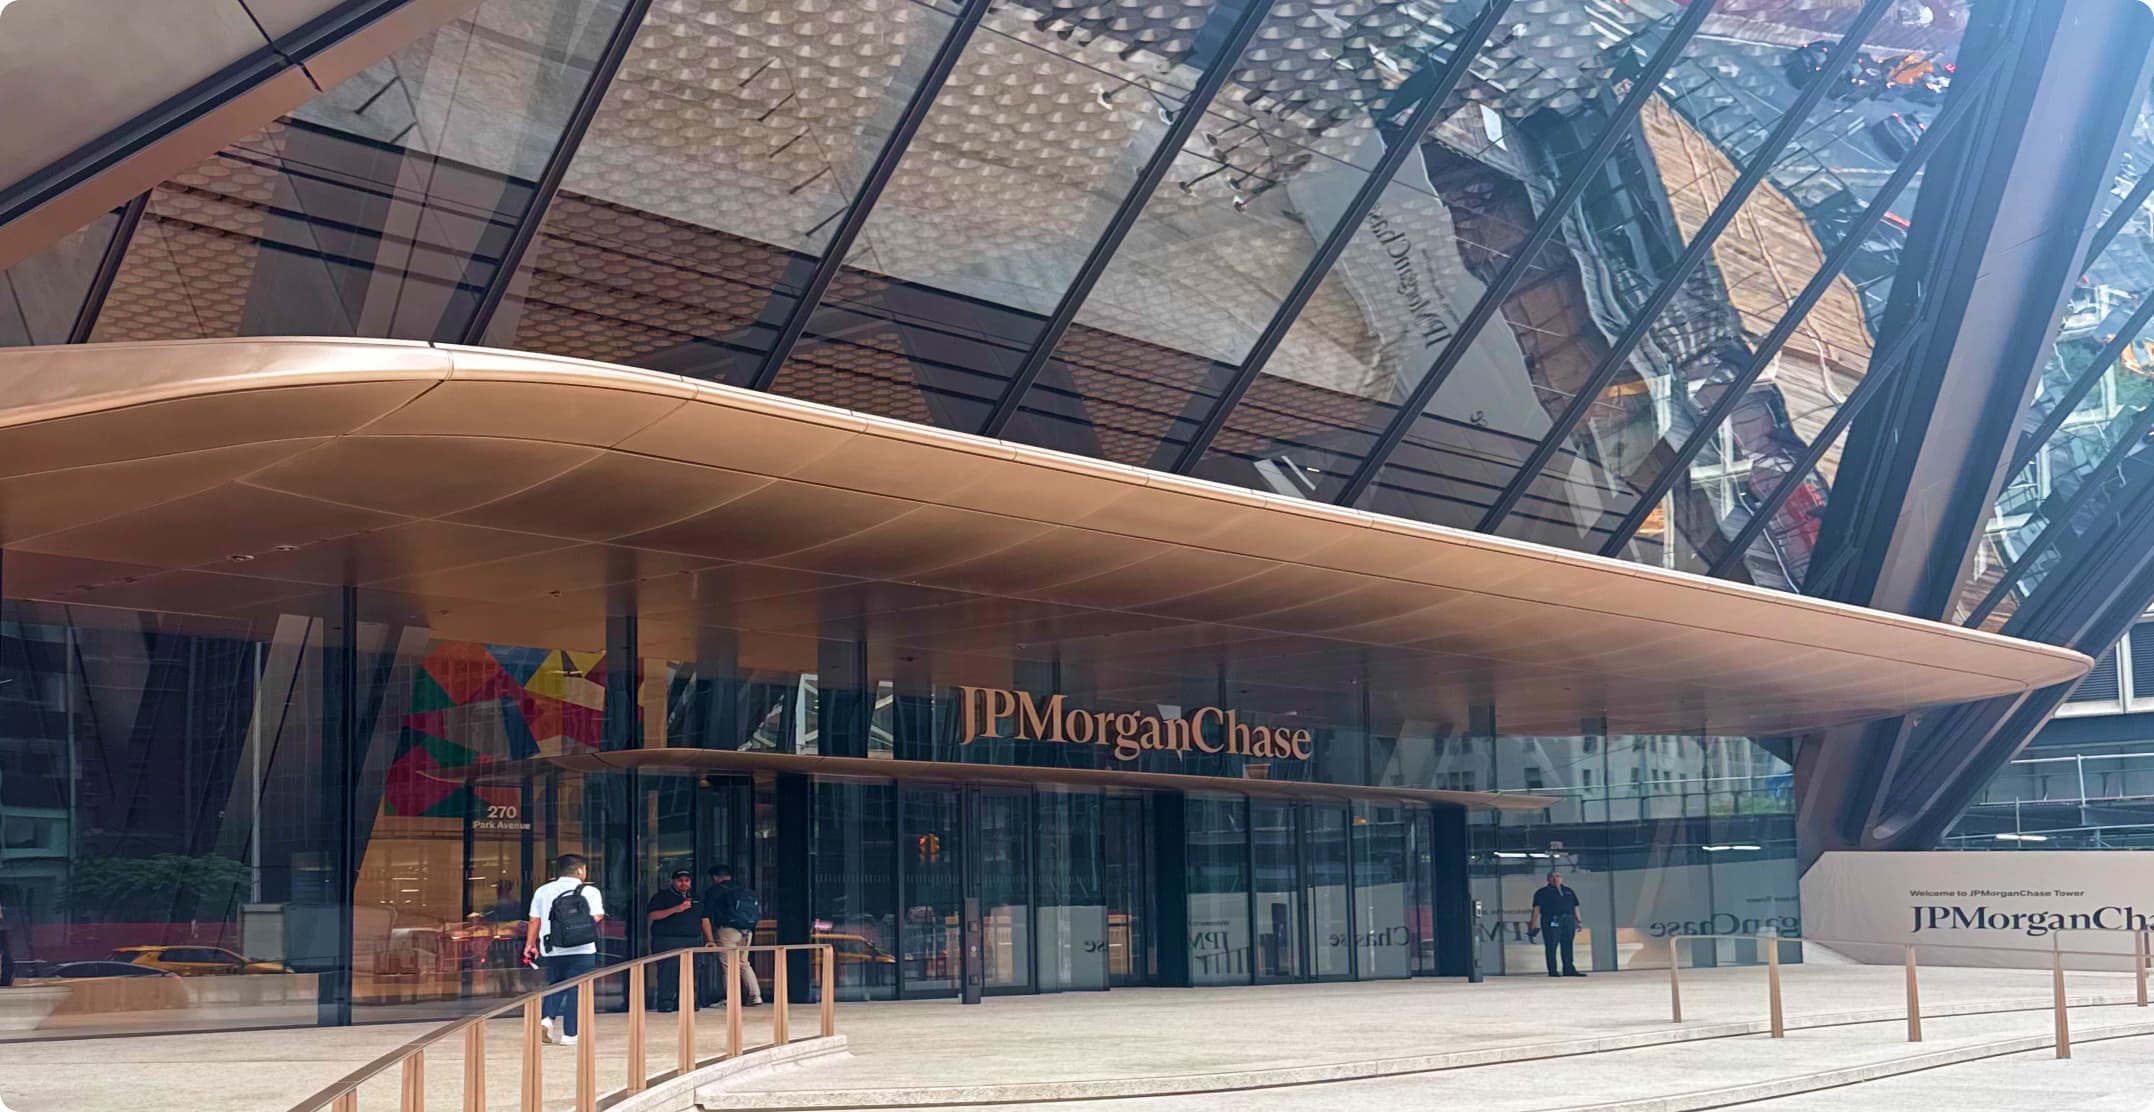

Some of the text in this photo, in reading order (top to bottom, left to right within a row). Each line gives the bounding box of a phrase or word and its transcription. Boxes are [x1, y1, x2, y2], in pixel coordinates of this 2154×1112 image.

[959, 685, 1312, 761] JPMorganChase
[487, 805, 517, 819] 270
[473, 820, 532, 831] Park Avenue
[1909, 889, 2085, 899] Welcome to JPMorganChase Tower
